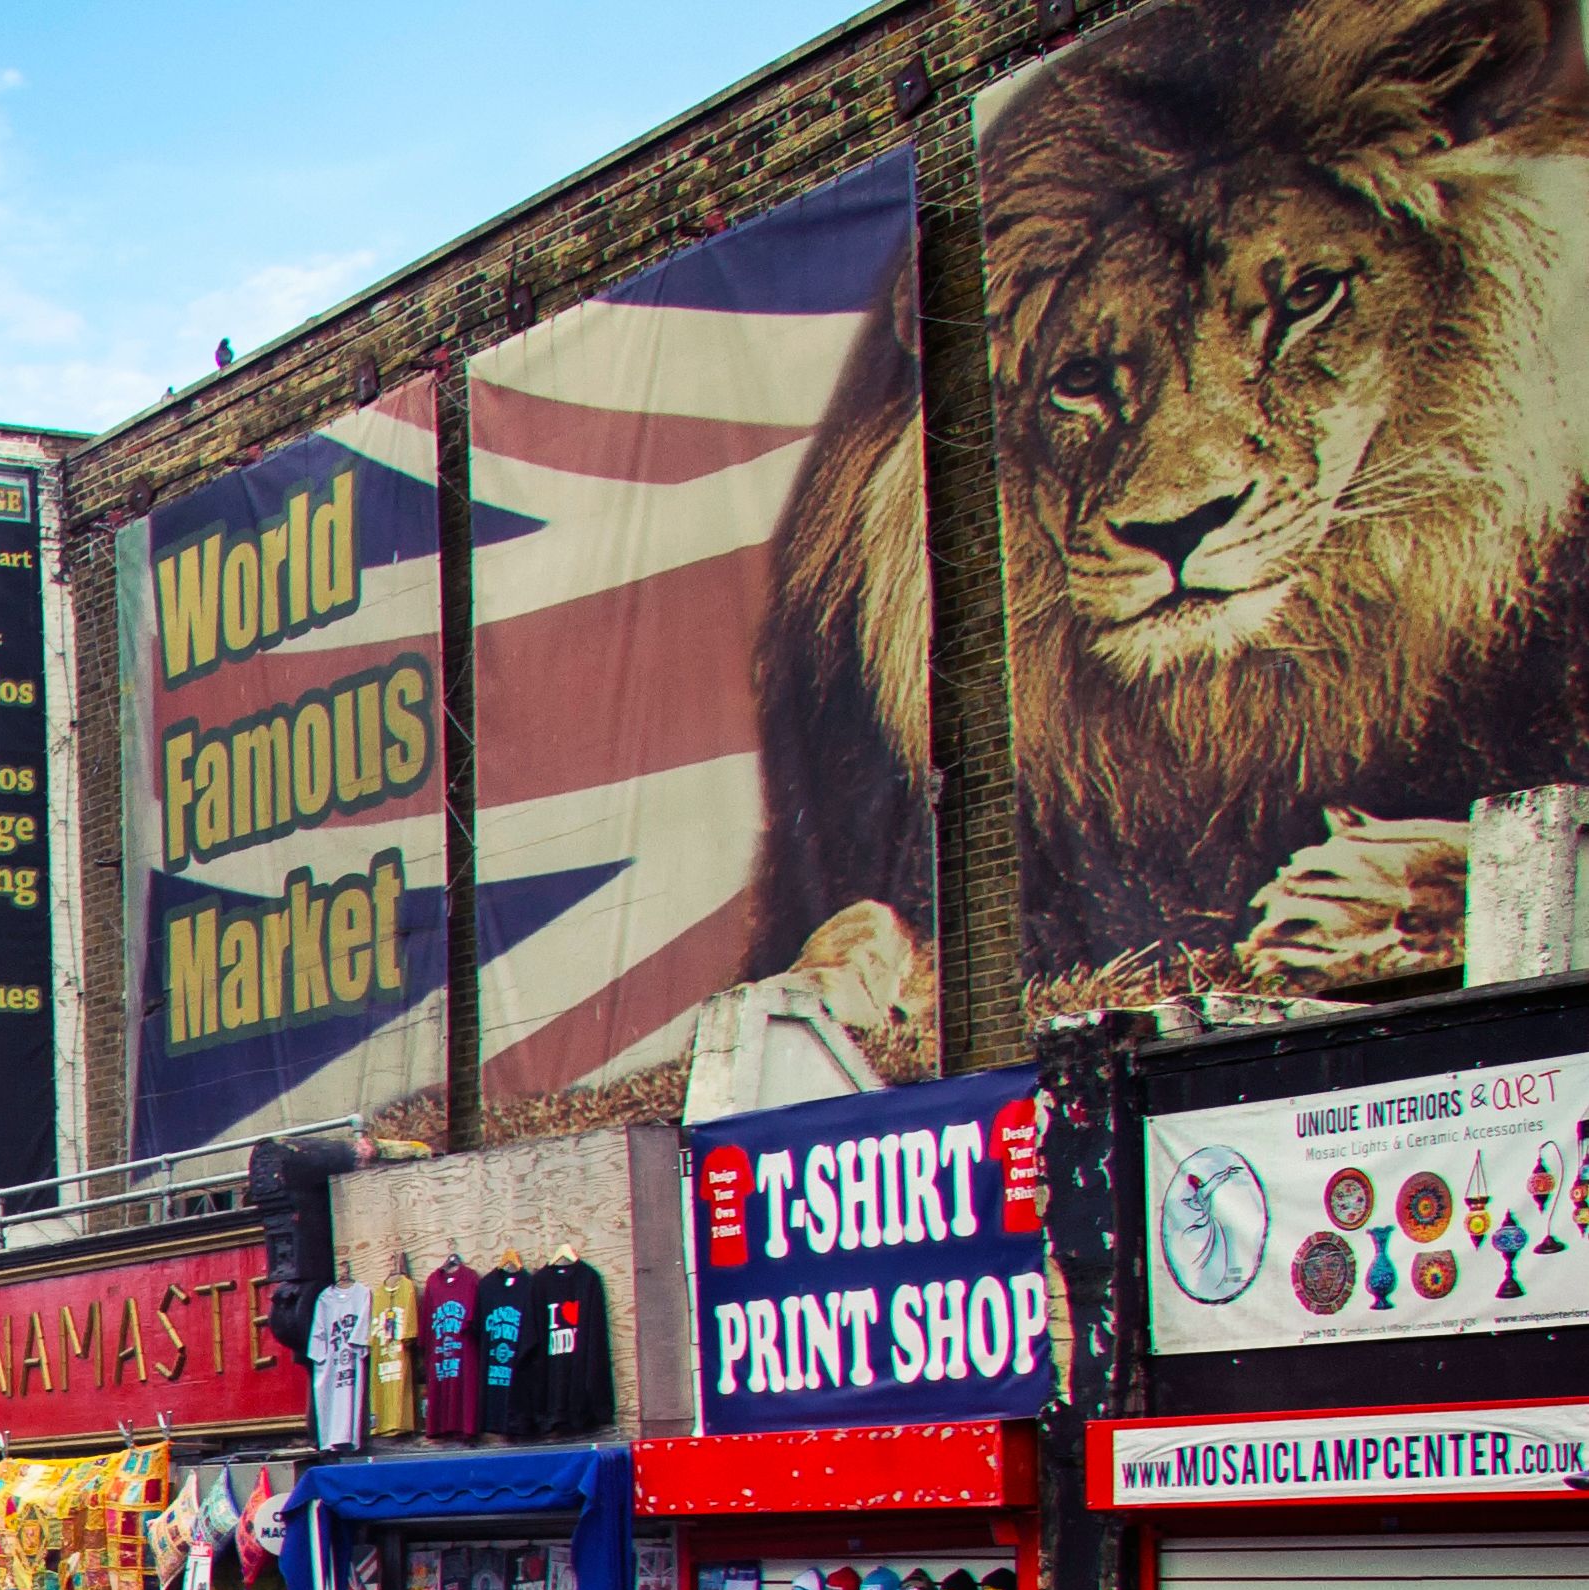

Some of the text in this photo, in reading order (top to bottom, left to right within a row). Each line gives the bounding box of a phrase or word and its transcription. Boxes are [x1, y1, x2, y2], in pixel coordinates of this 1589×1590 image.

[157, 471, 354, 680] World
[163, 667, 426, 862] Famous
[168, 862, 404, 1045] Market
[1296, 1105, 1360, 1138] UNIQUE
[1367, 1090, 1463, 1129] INTERIORS
[1471, 1083, 1488, 1108] &
[1306, 1119, 1544, 1161] Mosaic Lights & Ceramic Accessories
[709, 1169, 738, 1184] Design
[713, 1188, 735, 1201] Your
[755, 1120, 983, 1259] T-SHIRT
[711, 1224, 742, 1239] T-Shirt
[715, 1206, 736, 1219] Own
[547, 1302, 559, 1329] I
[715, 1271, 1048, 1395] PRINT SHOP
